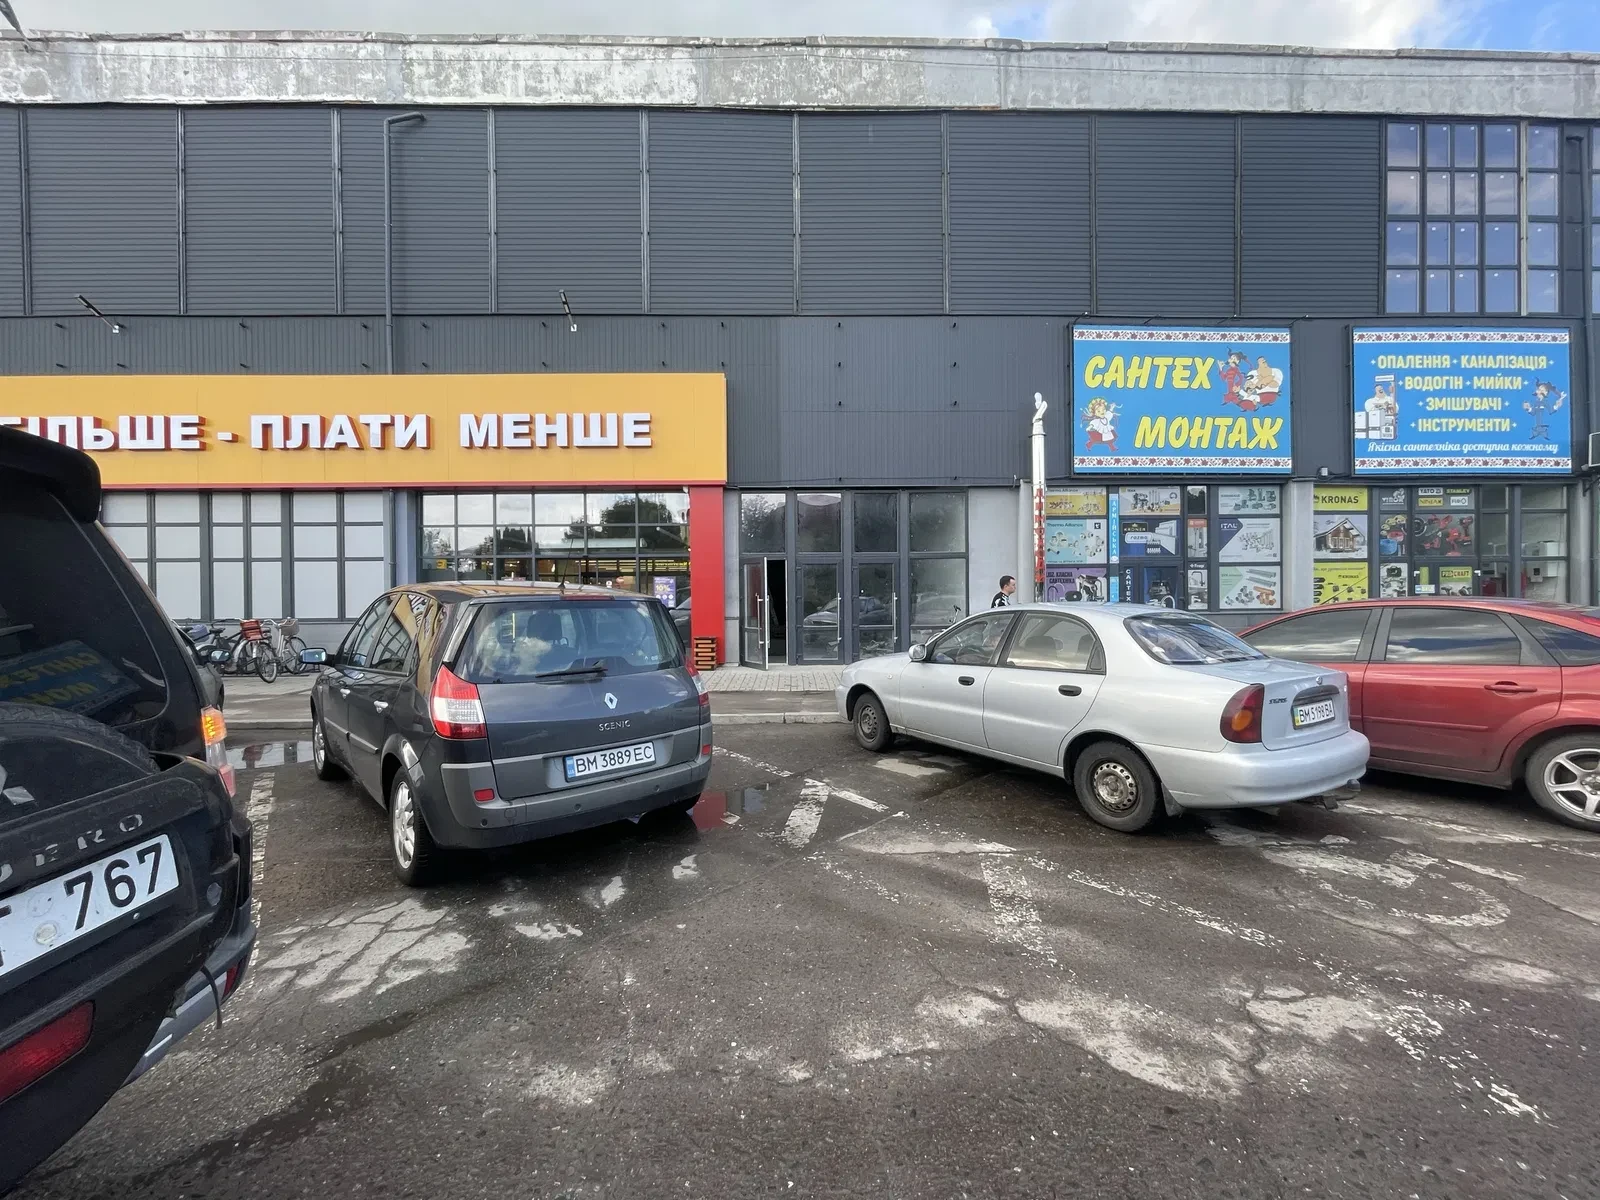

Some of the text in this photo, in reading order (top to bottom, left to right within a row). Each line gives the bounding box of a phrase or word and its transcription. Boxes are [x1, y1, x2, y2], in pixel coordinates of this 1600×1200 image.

[1377, 355, 1547, 371] ОПАЛЕННЯ КАНАЛІЗАЦІЯ
[1084, 356, 1215, 390] САНТЕХ
[1404, 376, 1463, 391] ВОДОГІН
[1473, 373, 1522, 390] МИЙКИ
[1426, 397, 1502, 411] ЗМІШУВАЧІ
[0, 415, 203, 450] ІЛЬШЕ
[251, 413, 429, 449] ПЛАТИ
[460, 412, 653, 448] МЕНШЕ
[1134, 416, 1283, 450] МОНТАЖ
[1418, 418, 1511, 432] ІНСТРУМЕНТИ
[1368, 441, 1401, 452] Якісна
[1462, 443, 1510, 454] доступна
[1321, 495, 1359, 504] KRONAS
[598, 720, 631, 731] SCENIC
[575, 746, 653, 773] BM 3889 EC
[63, 842, 162, 931] 767
